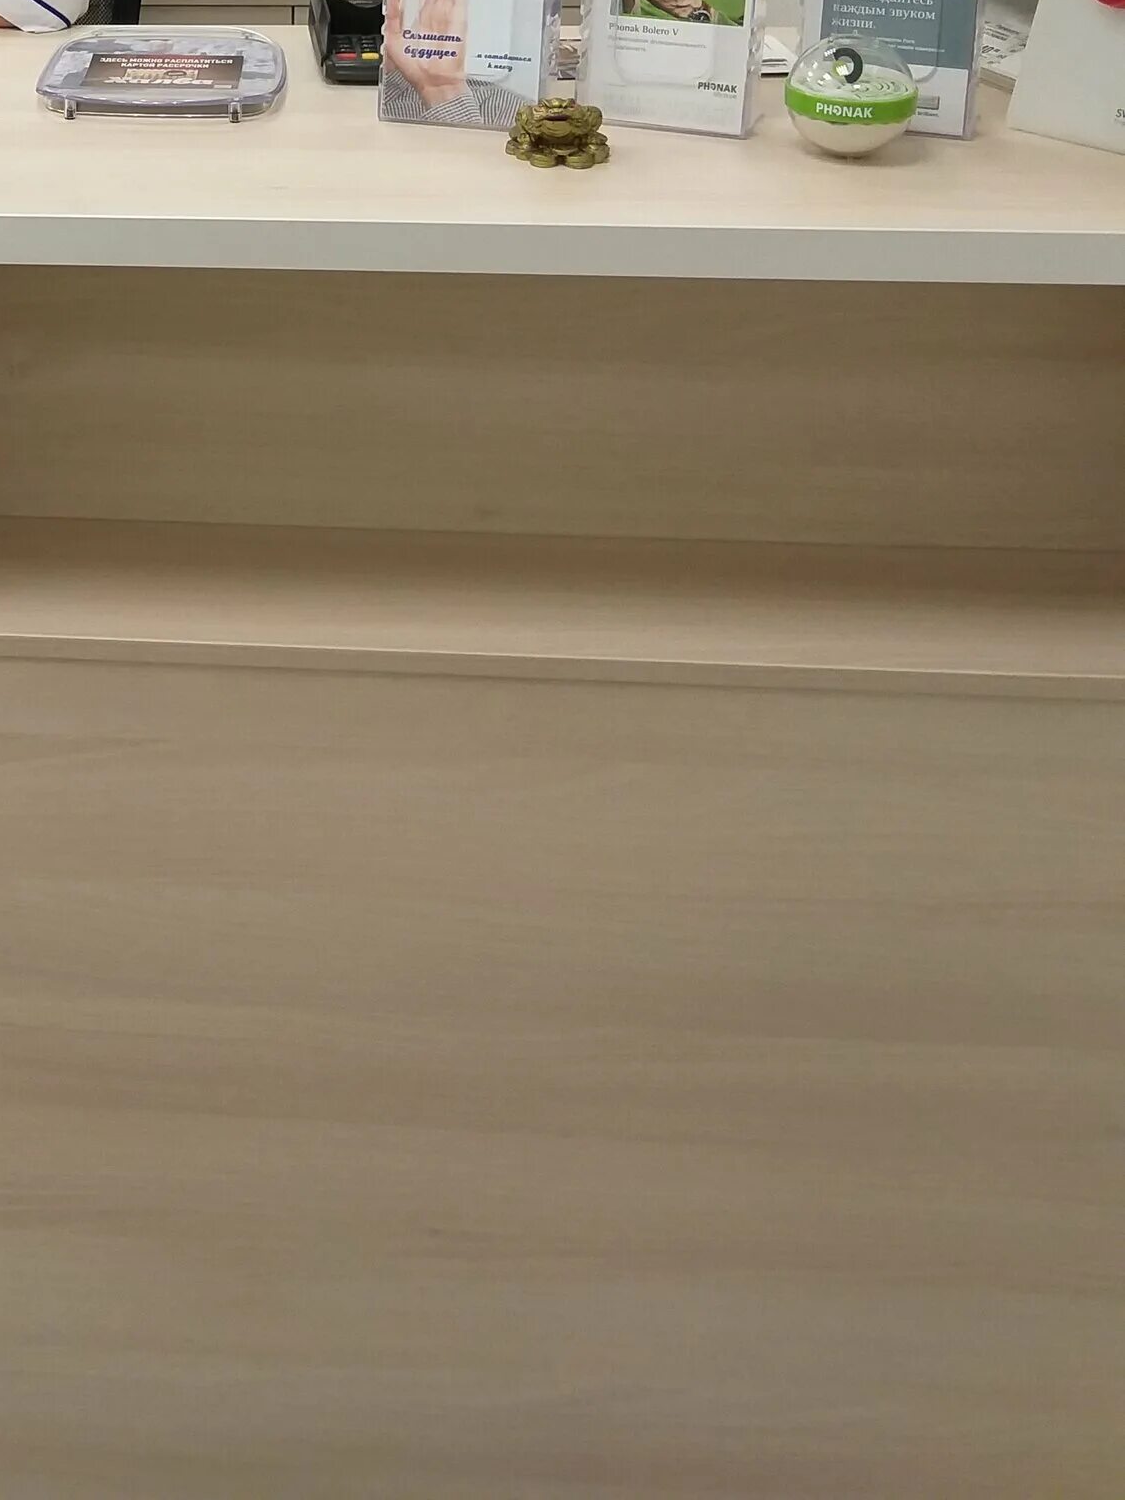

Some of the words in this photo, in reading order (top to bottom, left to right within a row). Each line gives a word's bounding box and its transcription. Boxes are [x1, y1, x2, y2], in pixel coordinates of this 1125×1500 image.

[833, 4, 885, 17] каждым
[890, 8, 936, 21] звуком
[642, 25, 670, 36] Bolero
[404, 46, 458, 60] будущее
[698, 81, 738, 94] PHONAK
[816, 102, 874, 119] PHONAK
